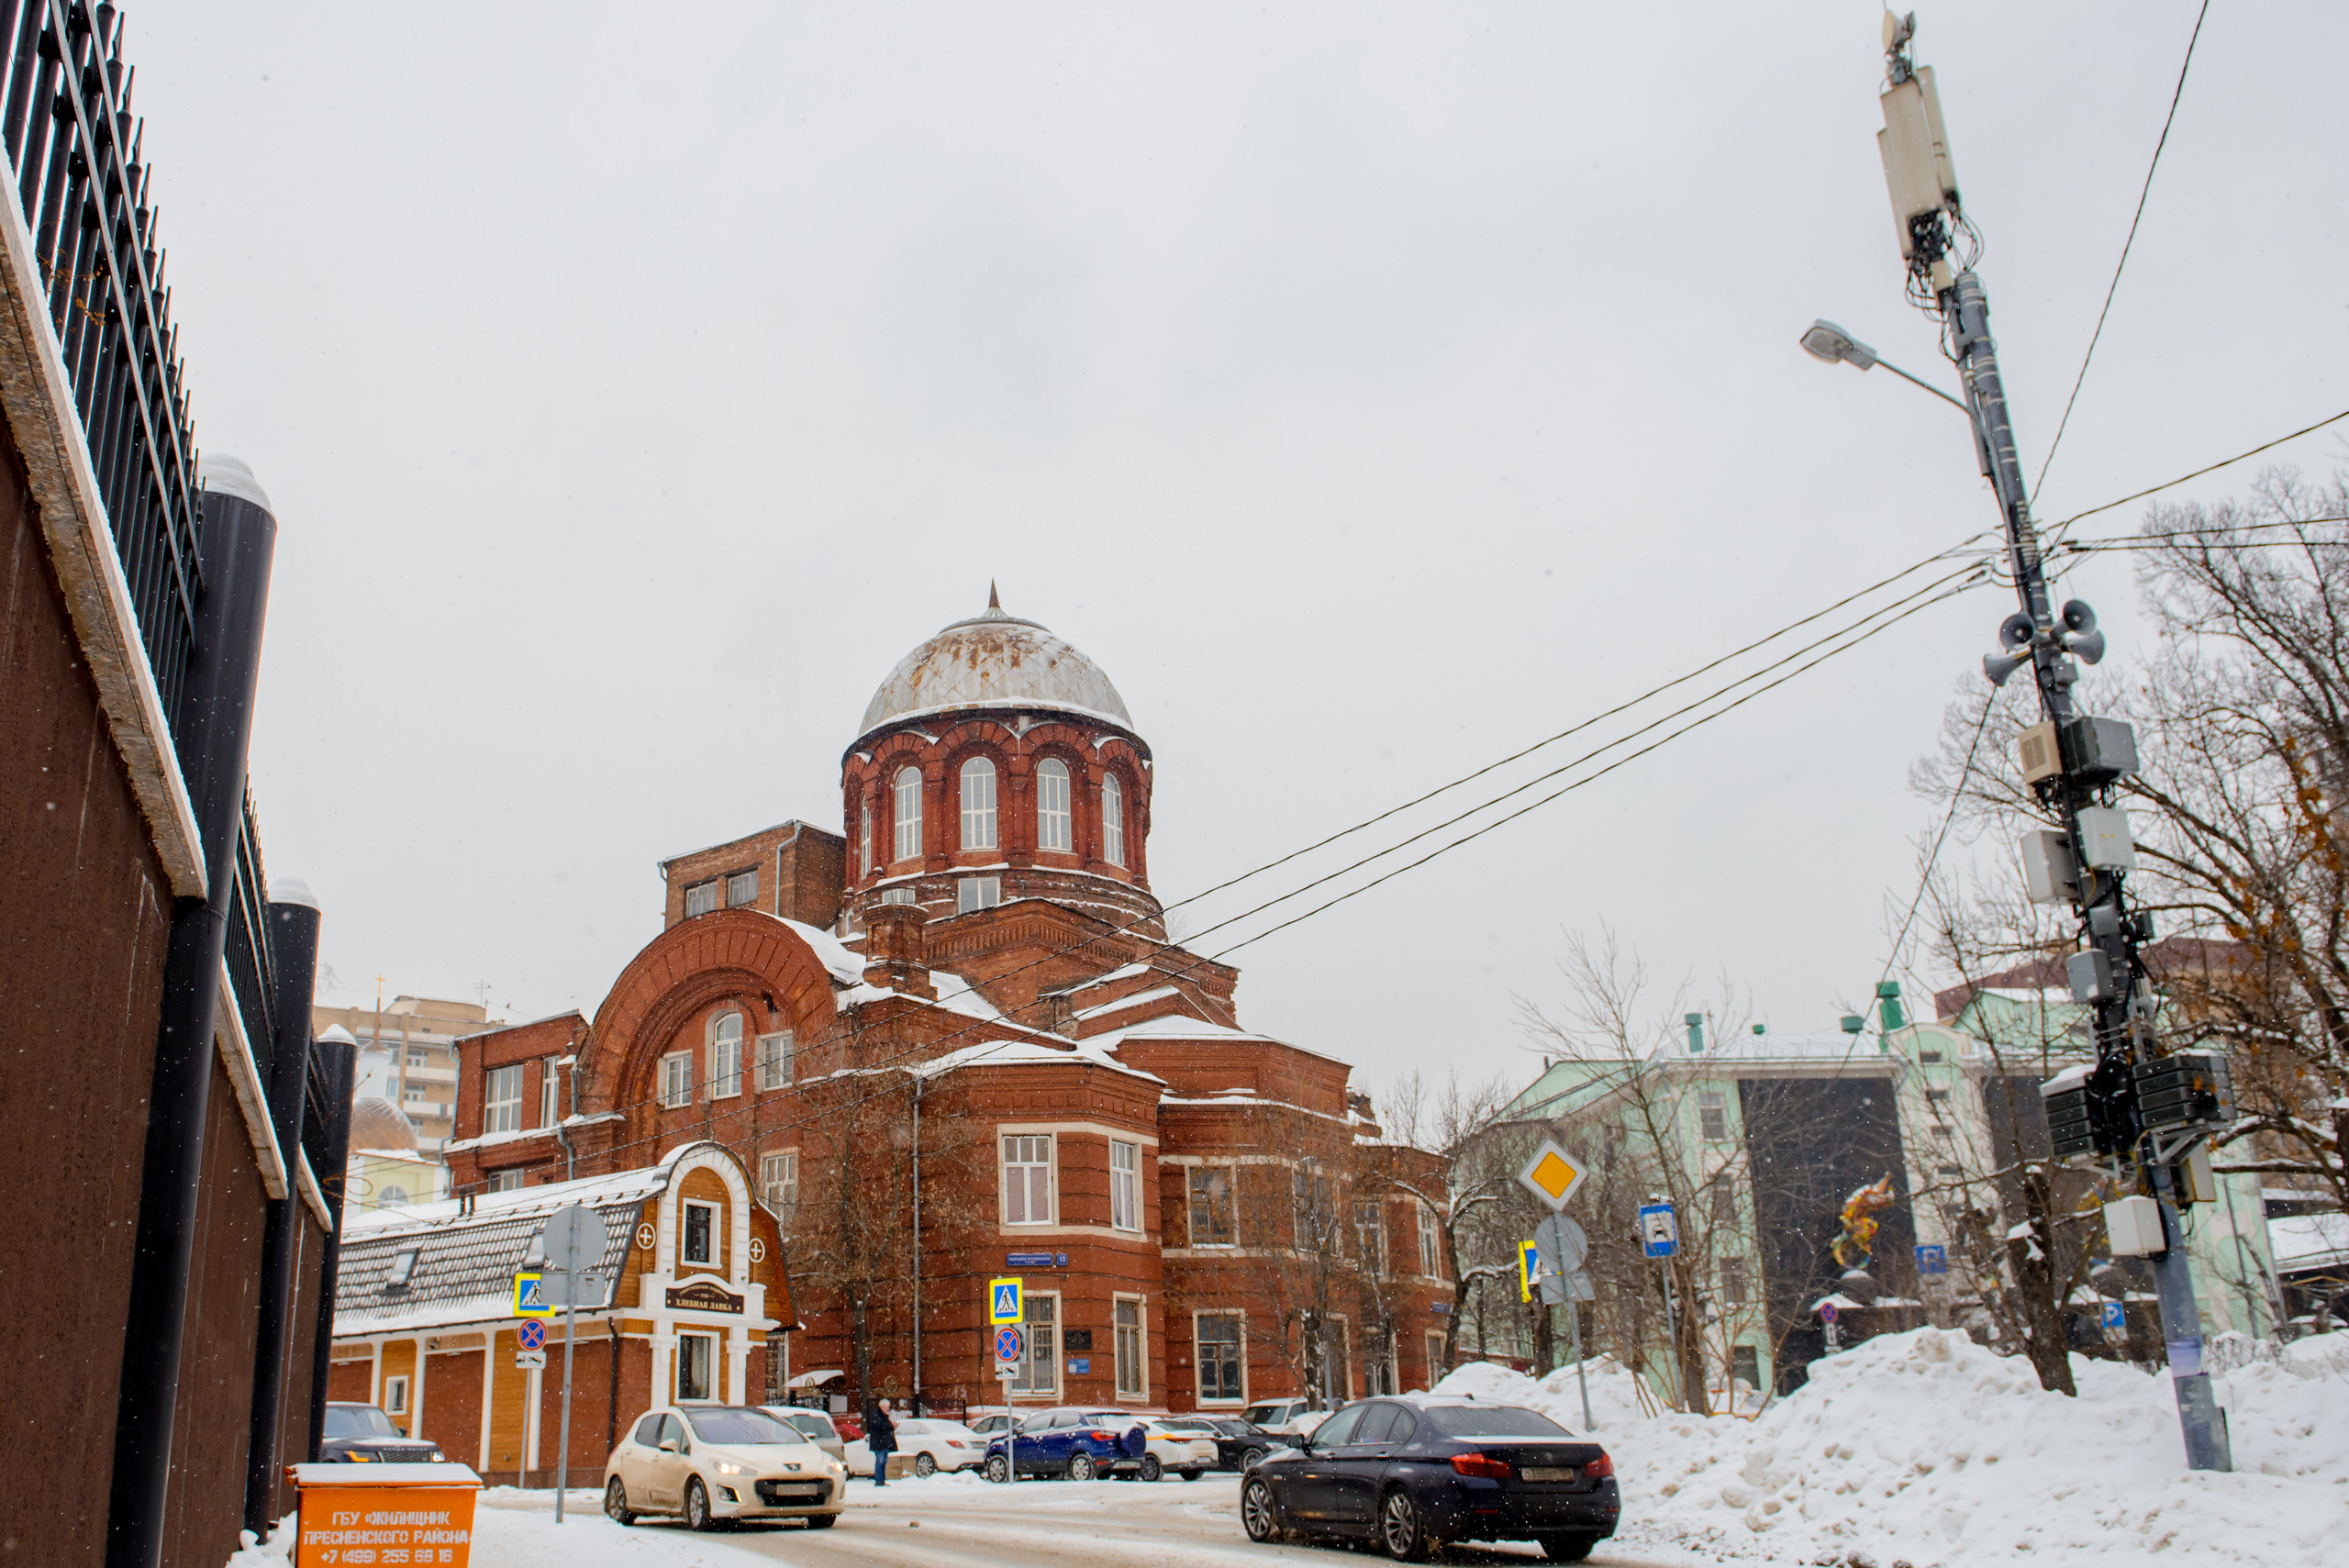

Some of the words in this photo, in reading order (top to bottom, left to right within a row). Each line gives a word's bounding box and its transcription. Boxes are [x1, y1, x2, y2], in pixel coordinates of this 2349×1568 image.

[675, 1298, 708, 1309] ХЛЕБНАЯ
[709, 1302, 733, 1311] ЛАВКА
[332, 1511, 361, 1526] ГБУ
[365, 1511, 451, 1527] «ЖИЛИЩНИК
[304, 1529, 409, 1545] ПРЕСНЕНСКОГО
[413, 1528, 471, 1544] РАЙОНА
[320, 1550, 339, 1563] +7
[341, 1549, 377, 1563] (499)
[381, 1549, 410, 1563] 255
[414, 1548, 434, 1563] 68
[439, 1549, 453, 1563] 16
